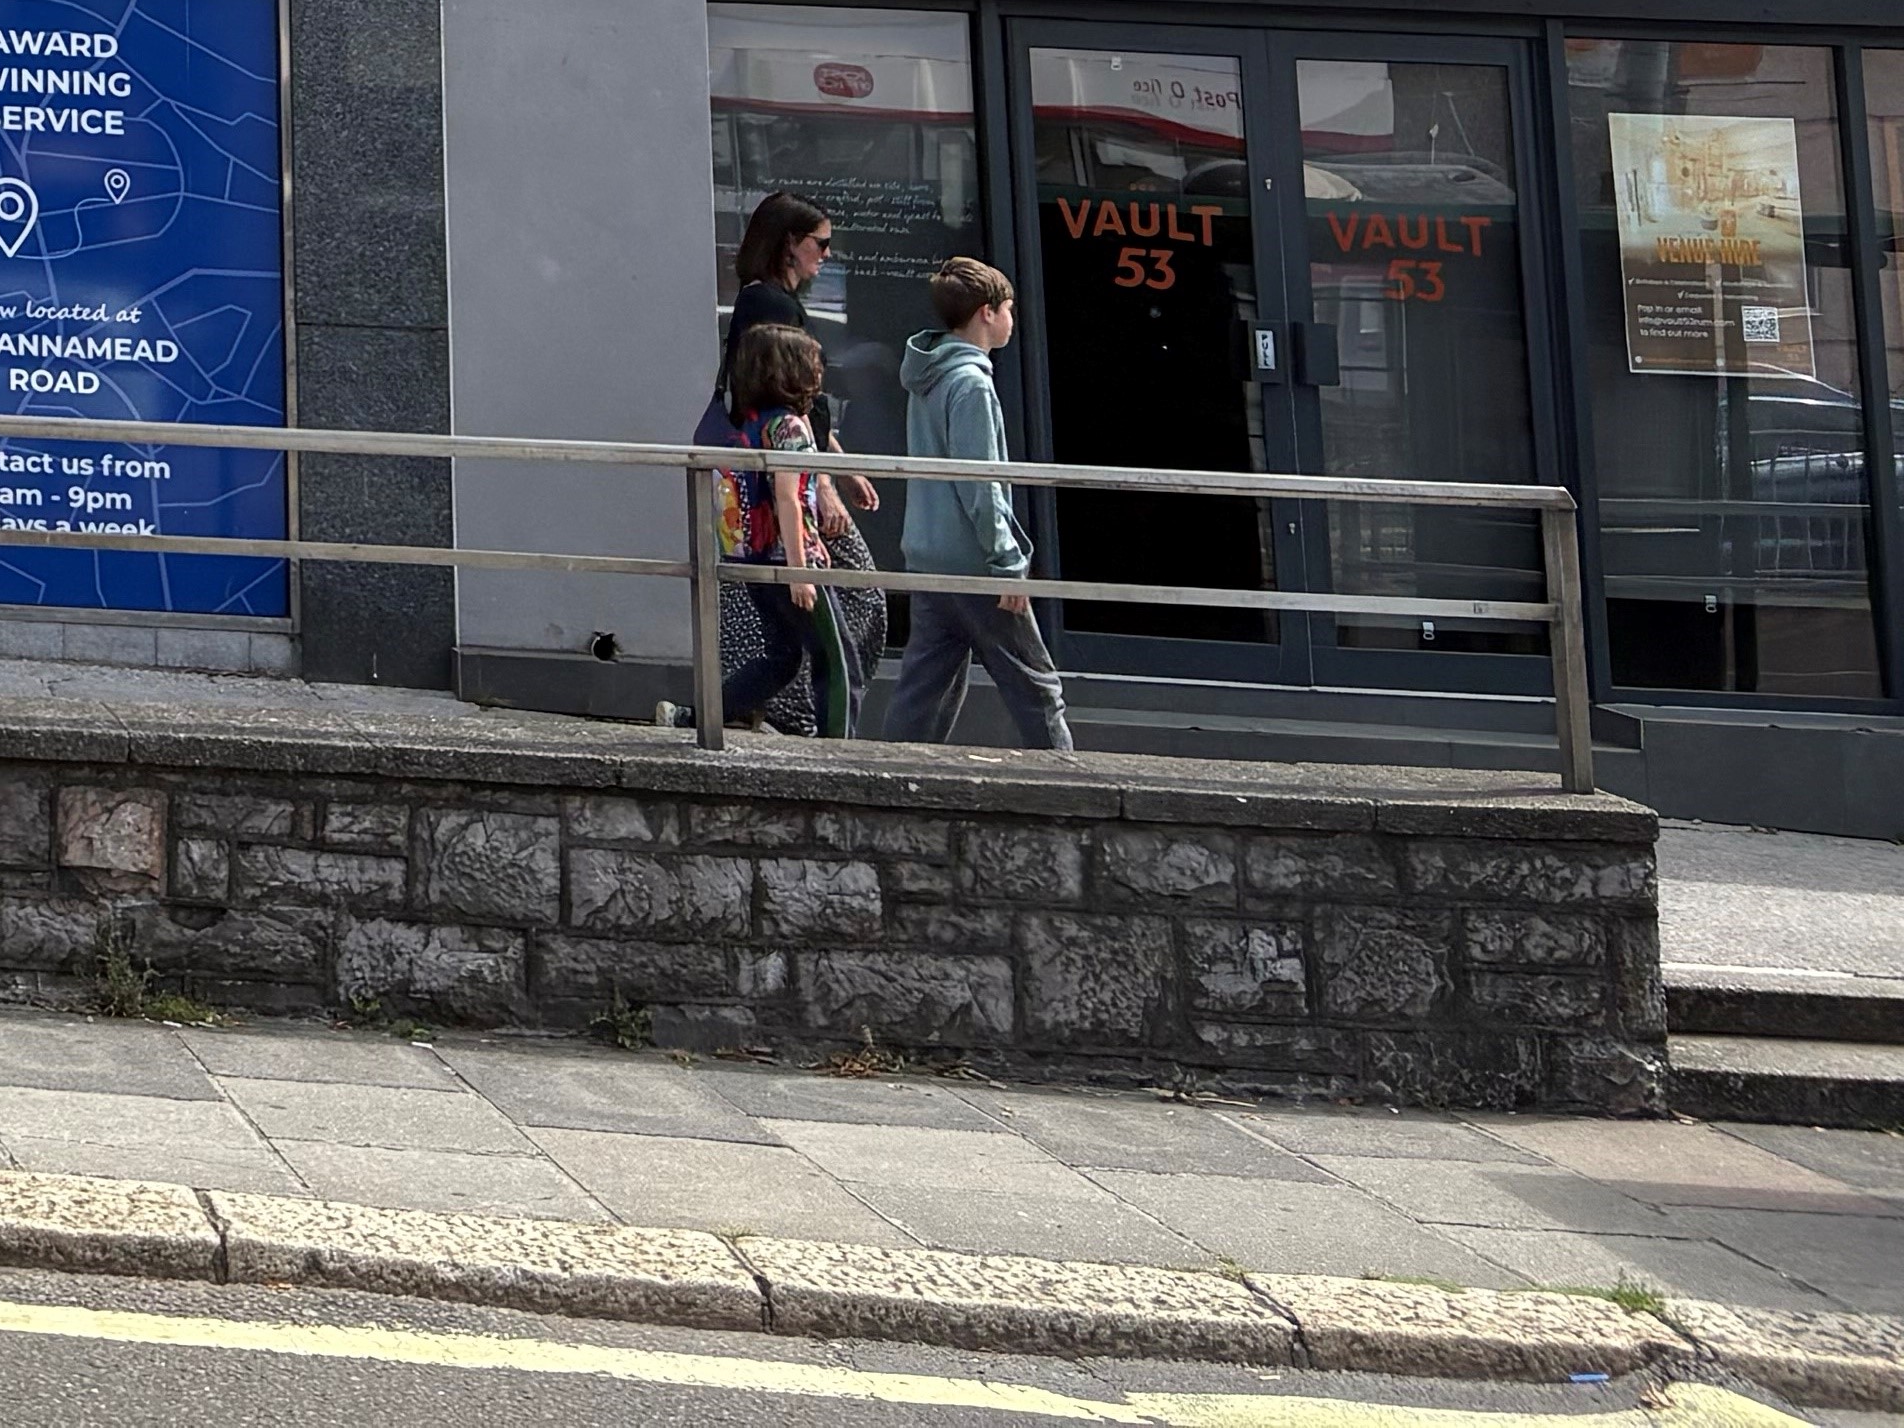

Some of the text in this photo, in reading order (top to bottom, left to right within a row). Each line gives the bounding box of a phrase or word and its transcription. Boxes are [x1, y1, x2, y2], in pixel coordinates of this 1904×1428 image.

[1056, 197, 1224, 247] VAULT
[1328, 210, 1492, 257] VAULT
[1656, 236, 1715, 263] VENUE
[1114, 247, 1177, 290] 53
[1383, 260, 1446, 302] 53
[25, 299, 111, 323] located
[115, 305, 143, 324] at
[8, 367, 101, 395] ROAD
[62, 457, 95, 476] us
[101, 453, 172, 480] from
[67, 485, 133, 514] 9pm
[78, 517, 156, 538] week
